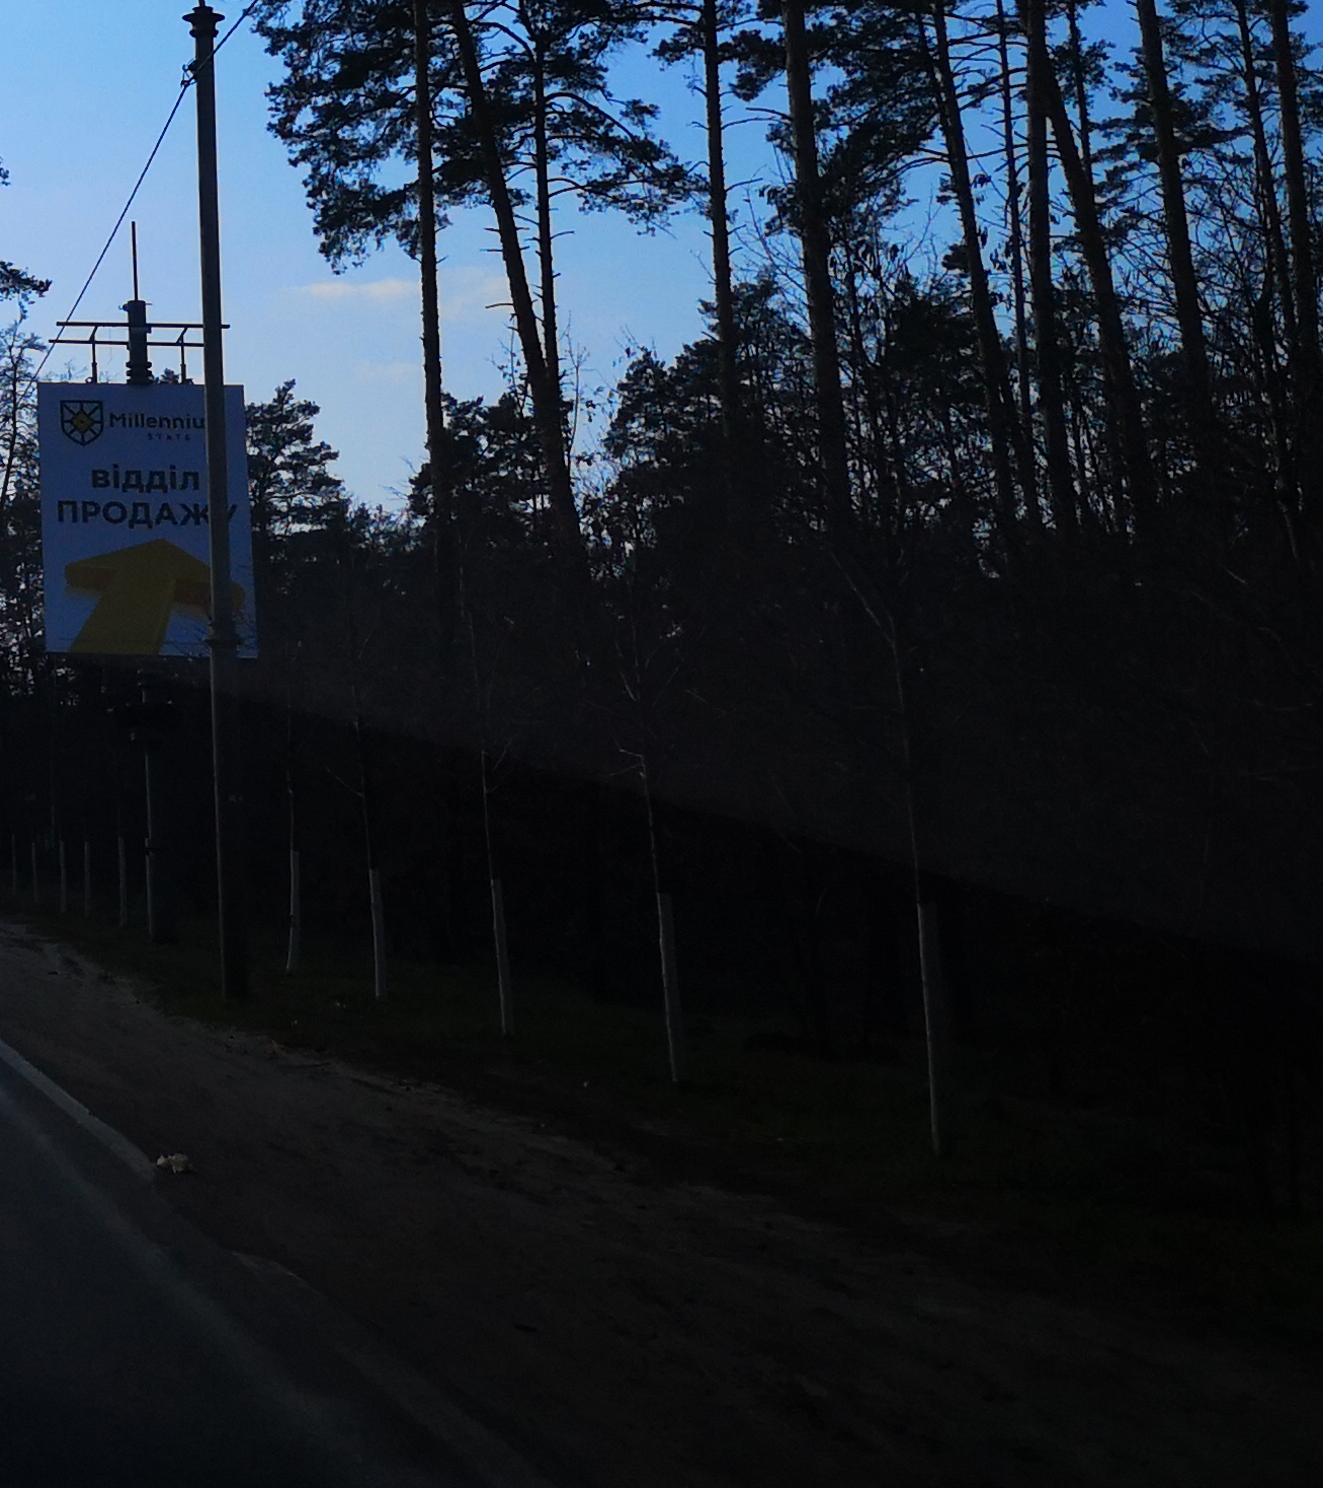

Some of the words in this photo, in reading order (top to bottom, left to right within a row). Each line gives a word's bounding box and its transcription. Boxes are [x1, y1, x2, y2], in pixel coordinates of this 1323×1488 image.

[109, 412, 205, 429] Millenniu
[147, 432, 192, 441] STATE
[92, 464, 200, 494] відділ
